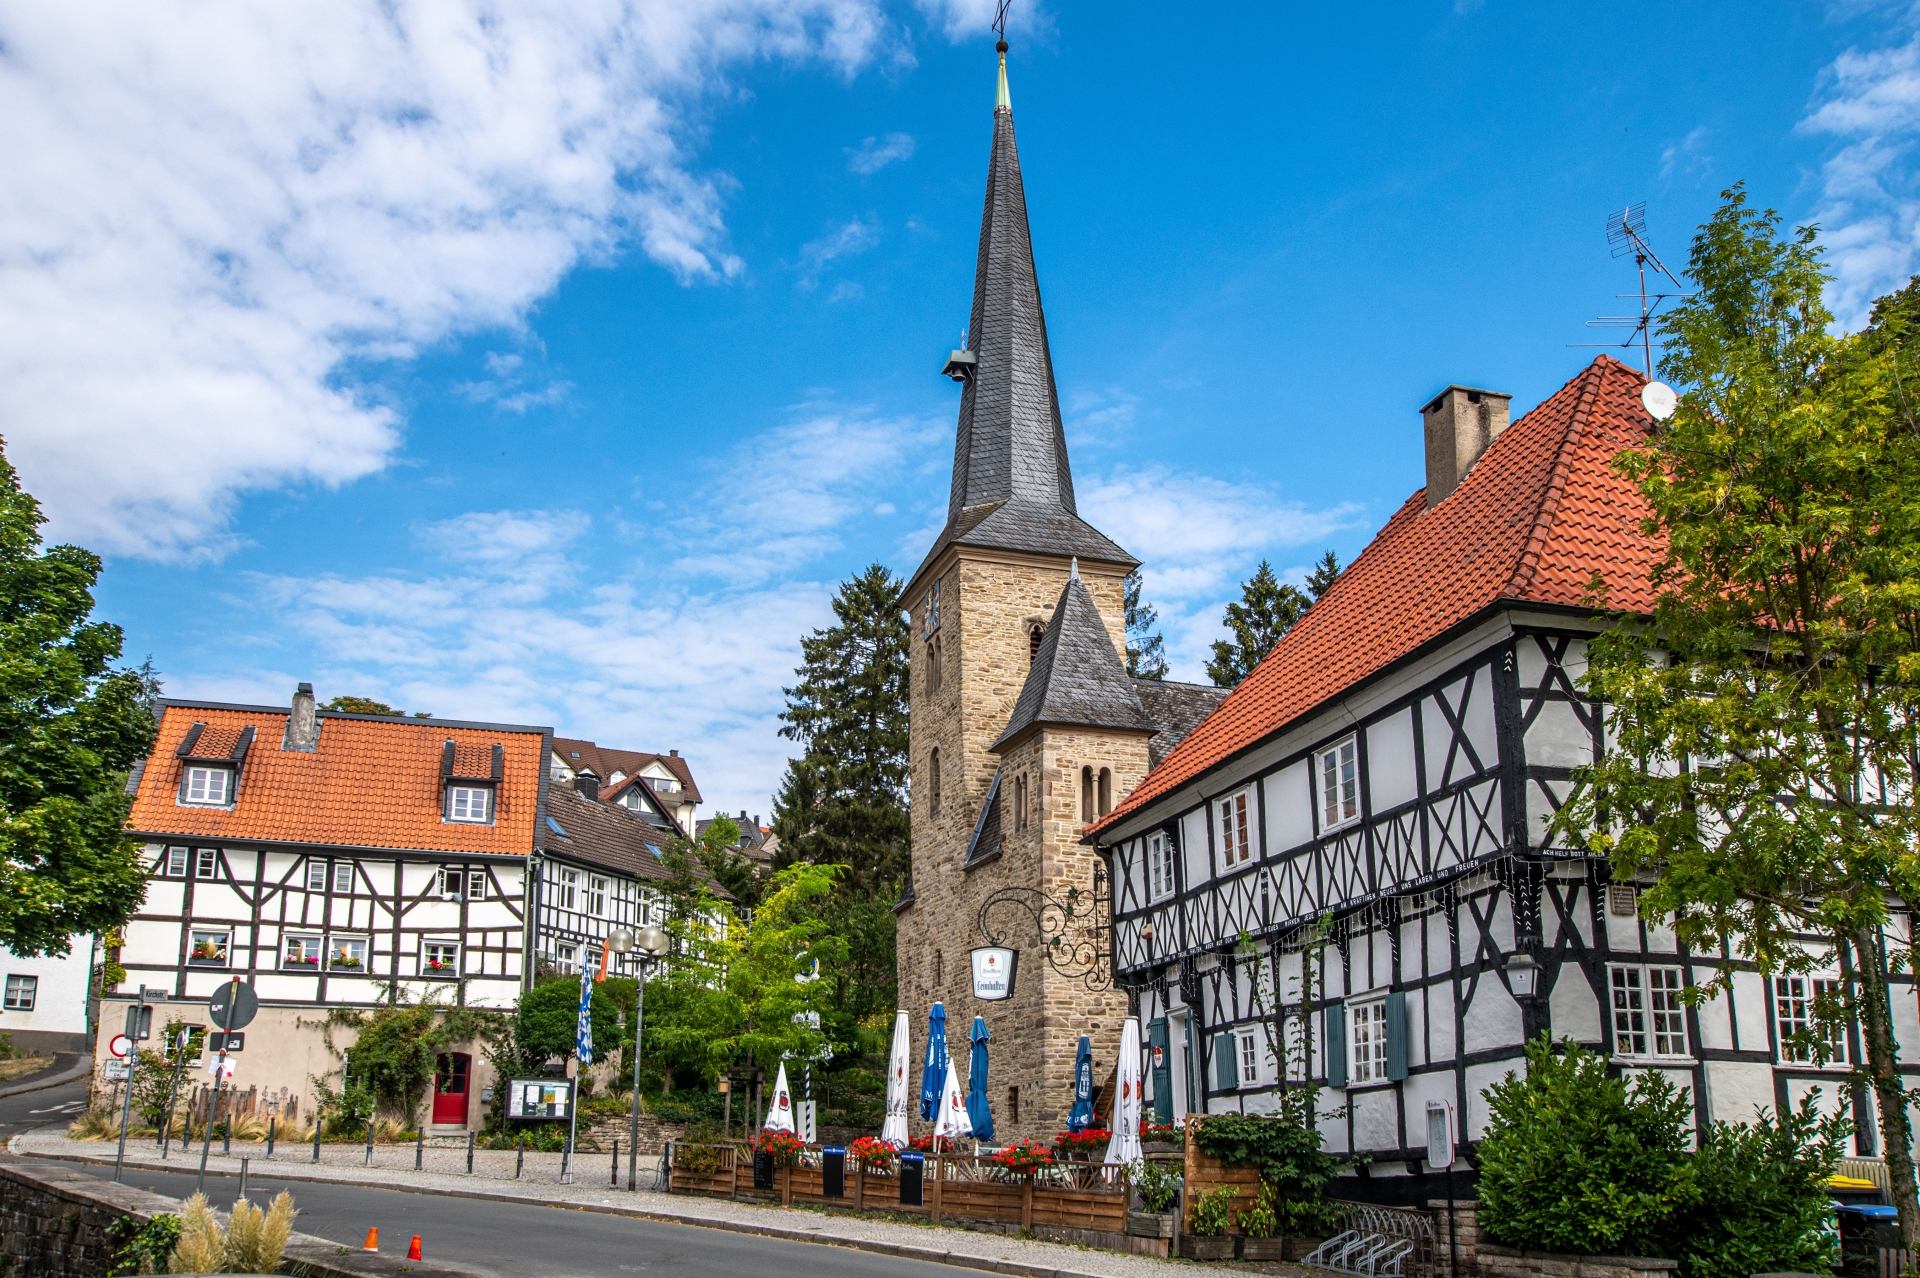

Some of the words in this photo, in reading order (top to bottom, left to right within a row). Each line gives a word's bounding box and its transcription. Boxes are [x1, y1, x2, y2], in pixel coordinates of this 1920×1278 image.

[1304, 912, 1315, 921] JEDE
[1317, 905, 1335, 917] STUNDE
[1380, 886, 1397, 896] NEUEN
[1401, 881, 1412, 890] UNS
[1415, 874, 1433, 886] LABEN
[1436, 869, 1449, 879] UND
[1455, 859, 1479, 873] FREUEN
[145, 990, 165, 999] Kirchstr.
